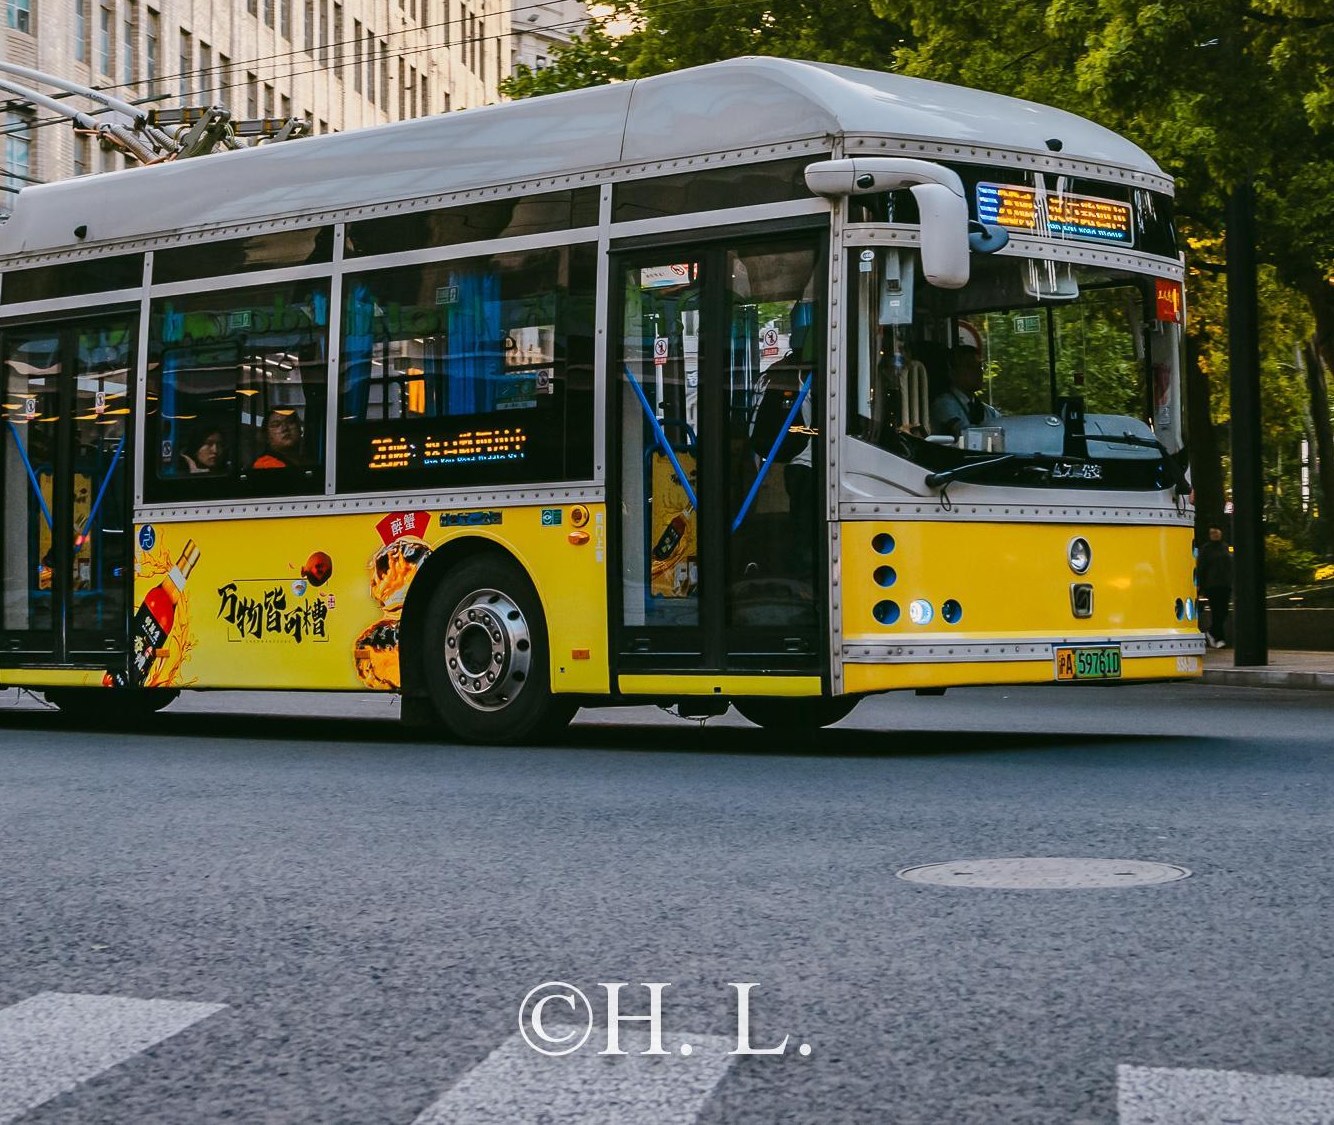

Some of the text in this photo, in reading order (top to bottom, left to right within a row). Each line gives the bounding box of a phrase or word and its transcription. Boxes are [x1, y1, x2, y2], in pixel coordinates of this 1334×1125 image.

[390, 513, 416, 537] 醉蟹
[217, 583, 328, 644] 万物皆可糟
